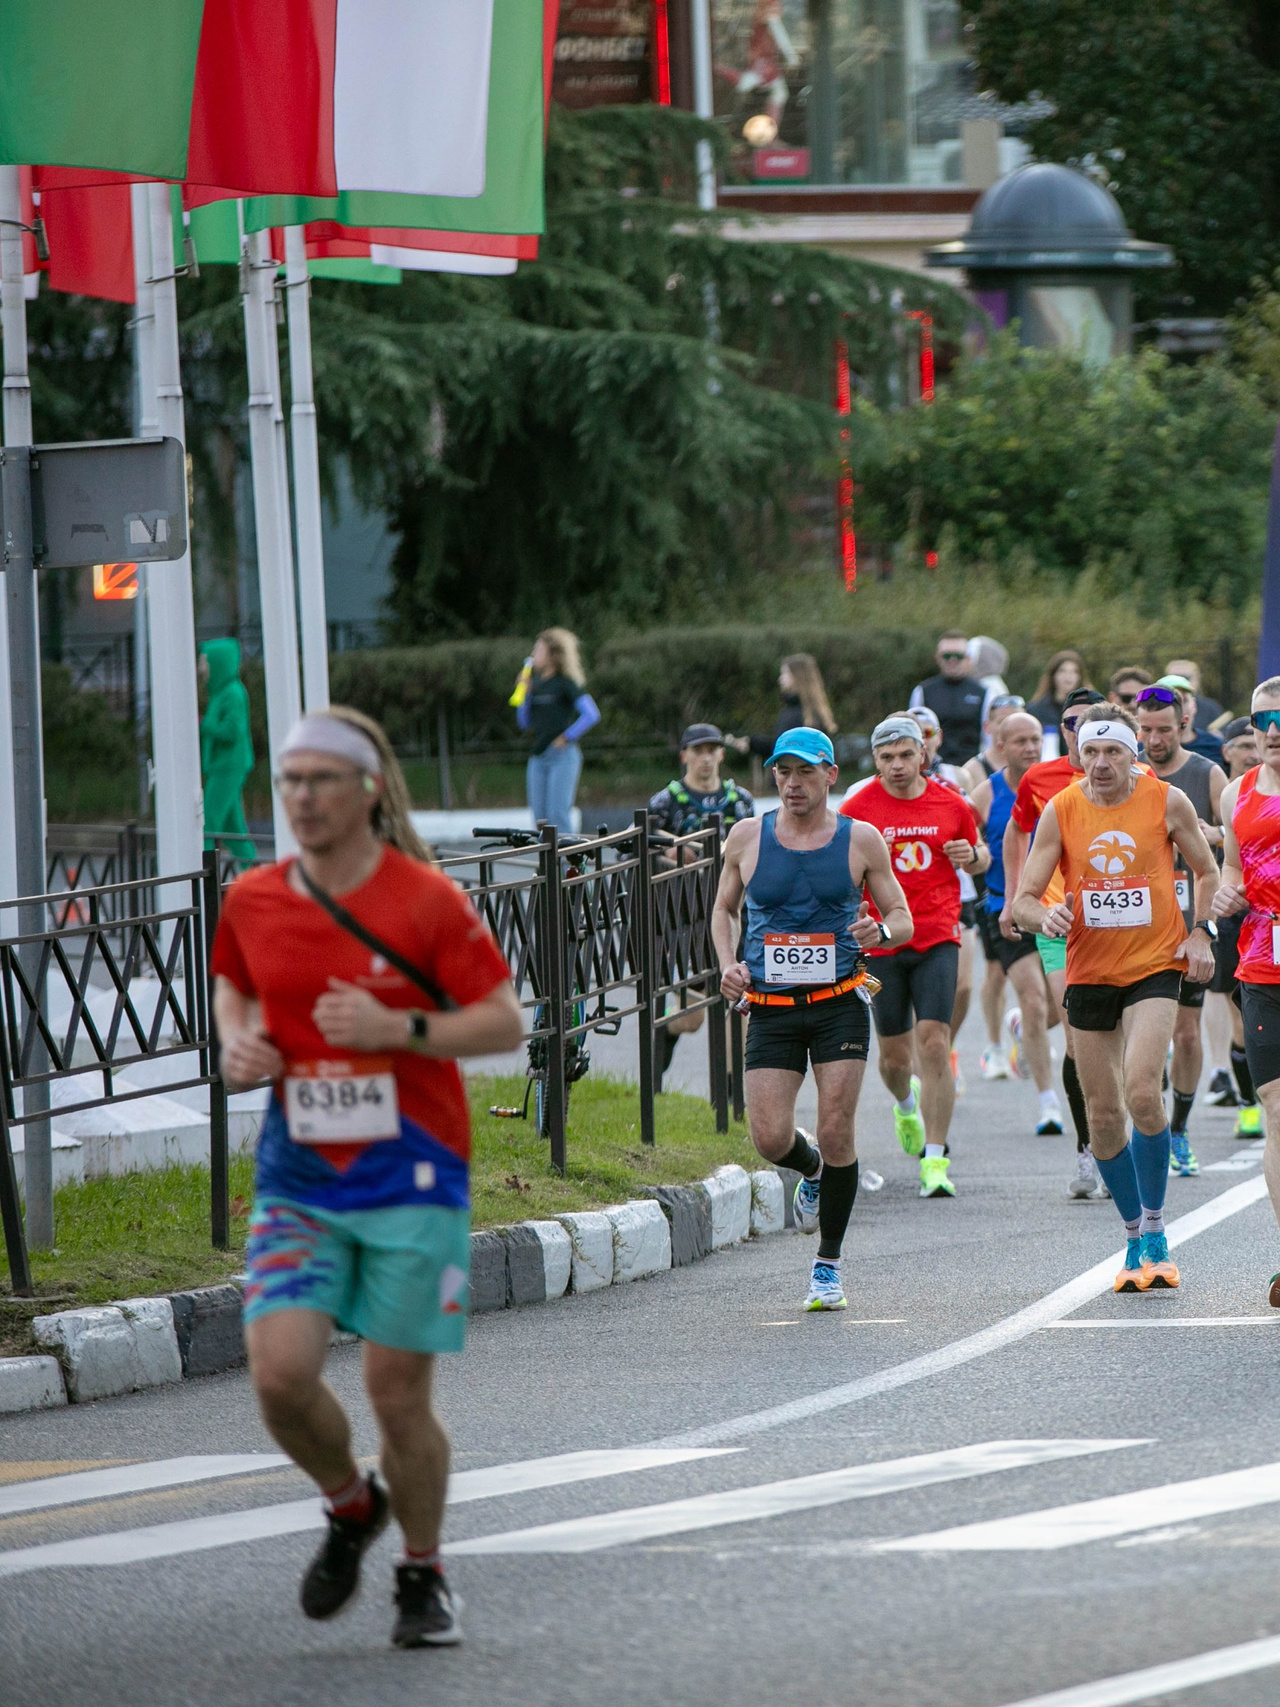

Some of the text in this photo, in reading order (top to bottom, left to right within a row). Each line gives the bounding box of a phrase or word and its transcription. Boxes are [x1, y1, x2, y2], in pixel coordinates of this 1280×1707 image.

[897, 826, 939, 837] МАГНИТ
[895, 841, 932, 873] 30
[1090, 890, 1144, 909] 6433
[773, 947, 828, 965] 6623
[296, 1079, 384, 1111] 6384
